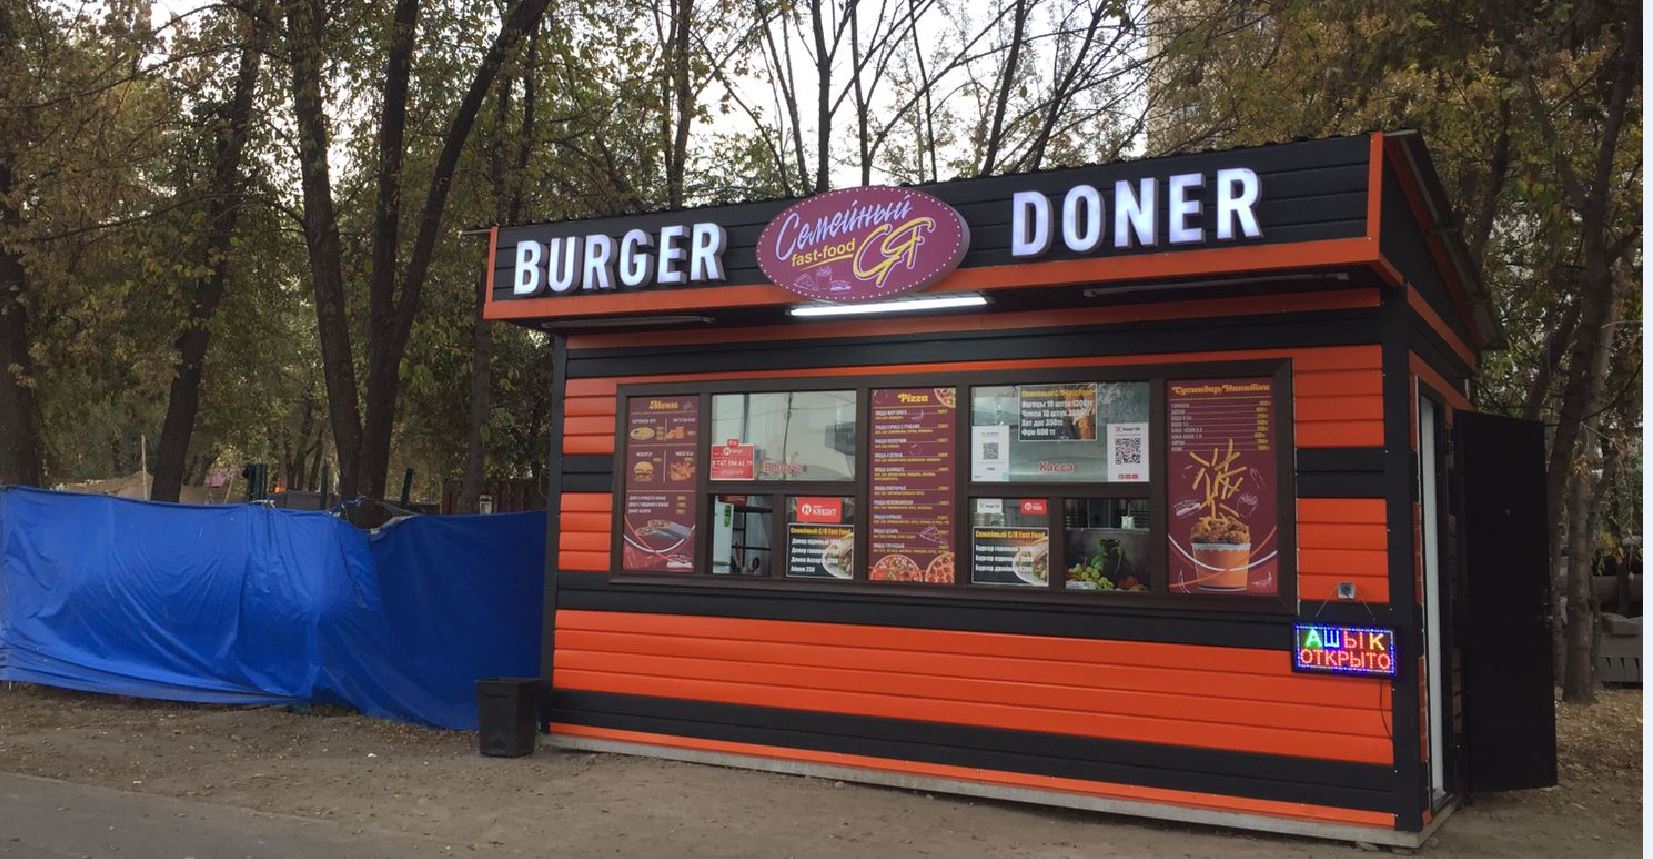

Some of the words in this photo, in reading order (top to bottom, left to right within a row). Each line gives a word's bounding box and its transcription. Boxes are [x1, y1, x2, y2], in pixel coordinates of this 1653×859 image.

[1012, 167, 1262, 257] DONER
[775, 195, 913, 261] Семейный
[513, 222, 727, 297] BURGER
[791, 237, 856, 267] fast-food
[897, 393, 928, 403] Pizza
[1038, 460, 1075, 473] Касса
[1300, 649, 1391, 670] ОТКРЫТО
